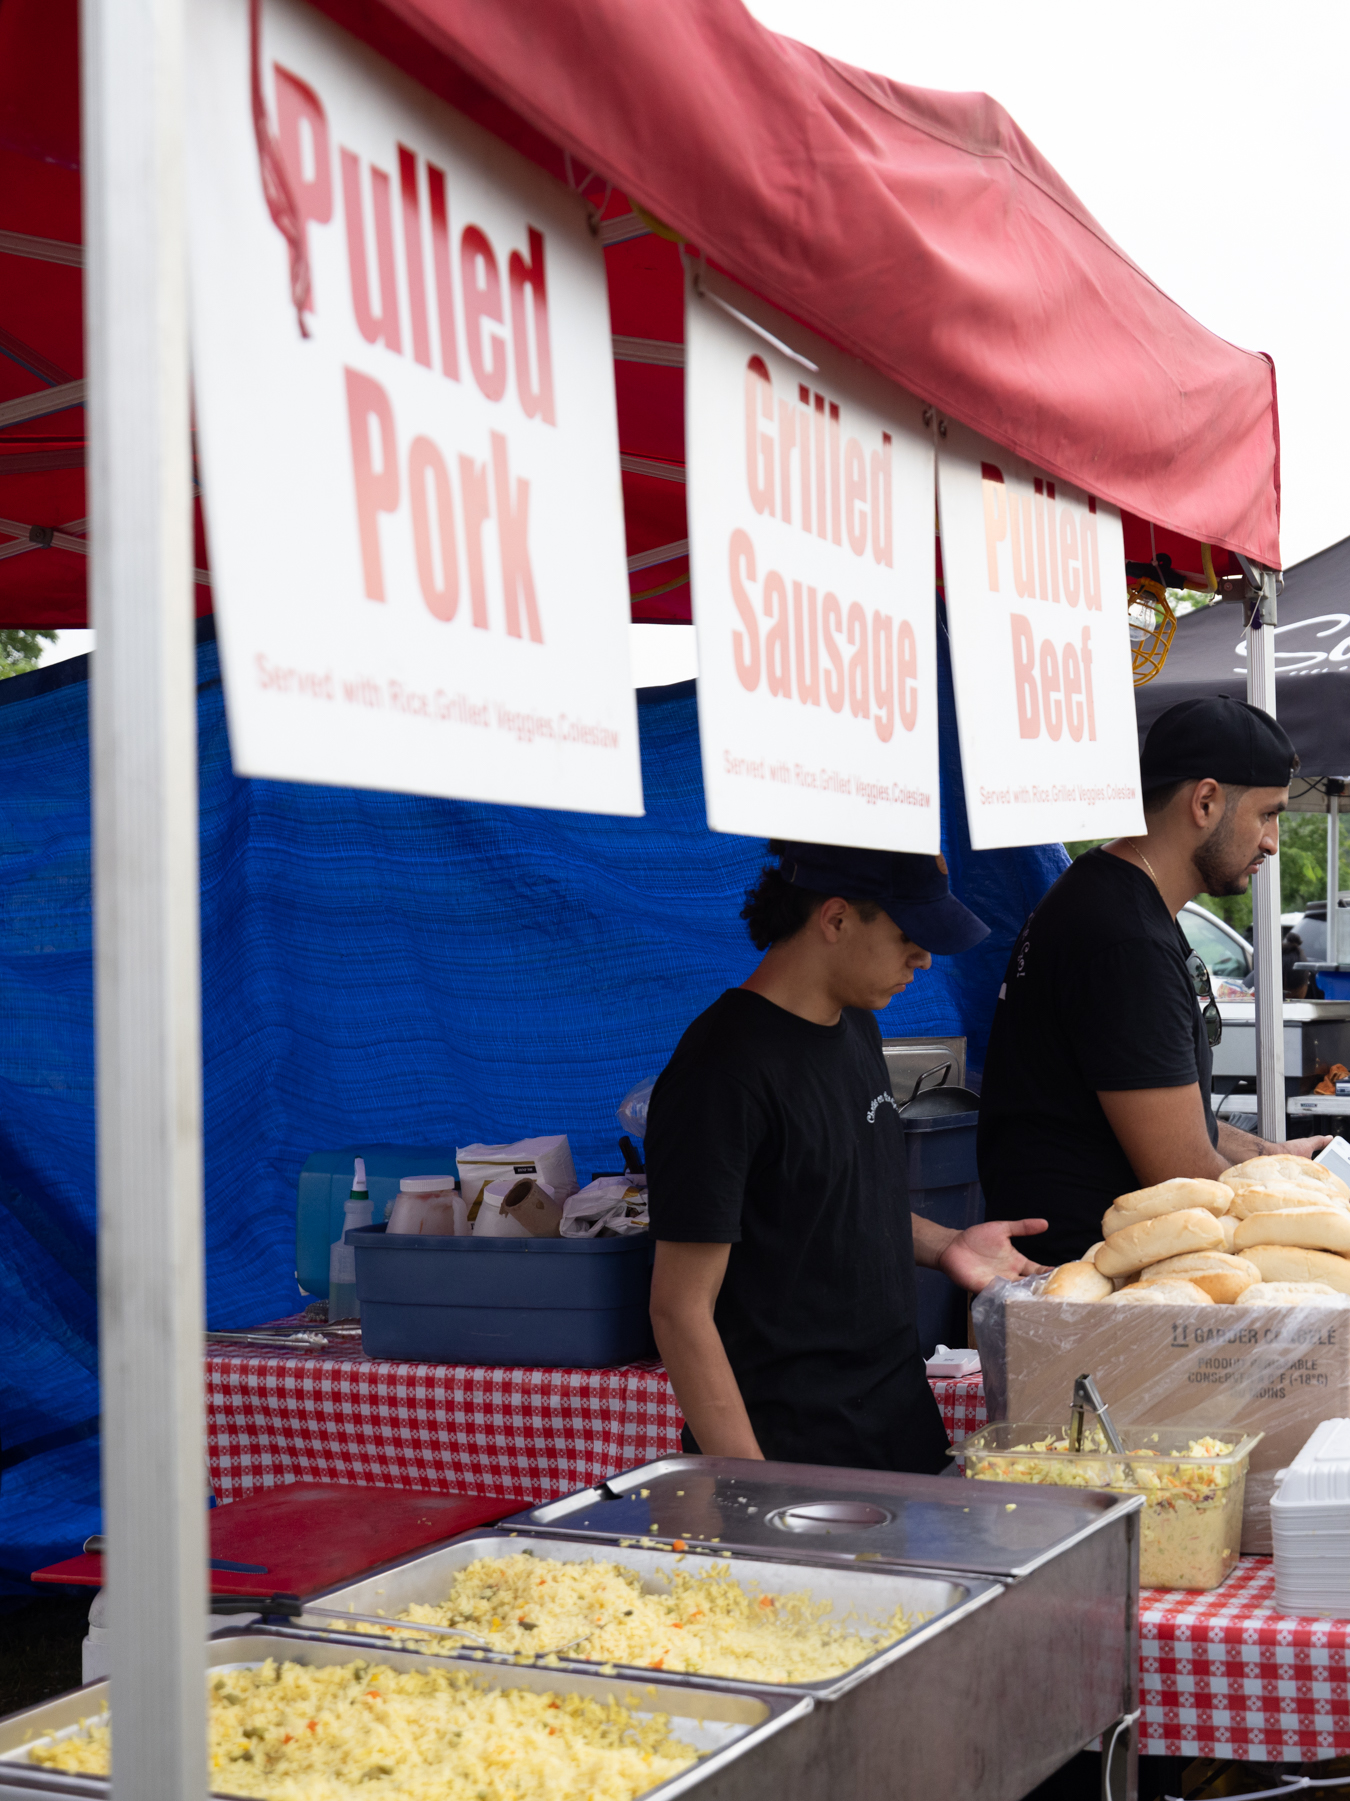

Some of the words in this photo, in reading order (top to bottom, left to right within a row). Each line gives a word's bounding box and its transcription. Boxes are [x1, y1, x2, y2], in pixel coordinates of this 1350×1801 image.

[273, 59, 557, 428] Pulled
[343, 363, 545, 646] Pork
[743, 353, 896, 570] Grilled
[980, 460, 1103, 613] Pulled
[254, 650, 334, 702] Served
[342, 673, 385, 711] with
[727, 526, 919, 745] Sausage
[1009, 611, 1098, 744] Beef
[723, 748, 766, 780] Served
[769, 761, 793, 785] with
[979, 785, 1011, 806] Served
[1012, 785, 1031, 804] with
[1194, 1327, 1259, 1345] GARDER
[1263, 1325, 1337, 1346] COGELÉ
